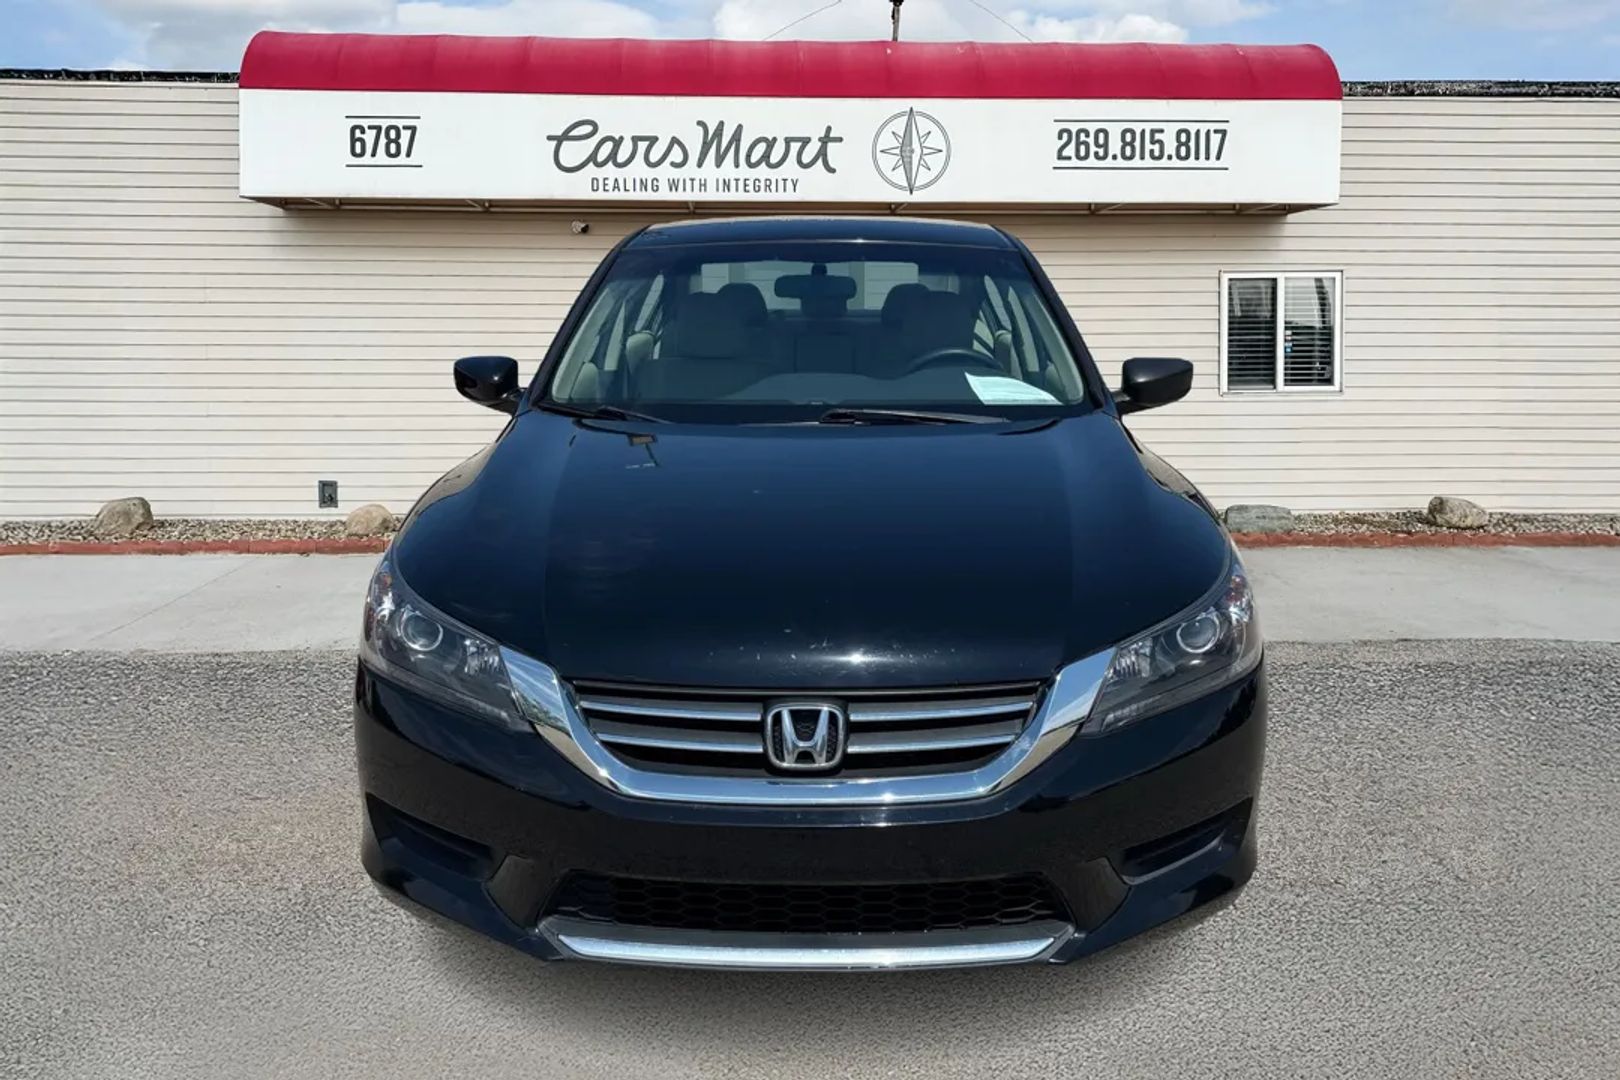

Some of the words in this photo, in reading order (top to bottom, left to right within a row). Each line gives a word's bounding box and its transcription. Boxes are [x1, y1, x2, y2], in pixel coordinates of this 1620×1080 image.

[349, 124, 419, 159] 6787
[1056, 126, 1229, 162] 269.815.8117
[591, 177, 660, 193] DEALING
[667, 177, 708, 193] WITH
[715, 177, 800, 194] INTEGRITY
